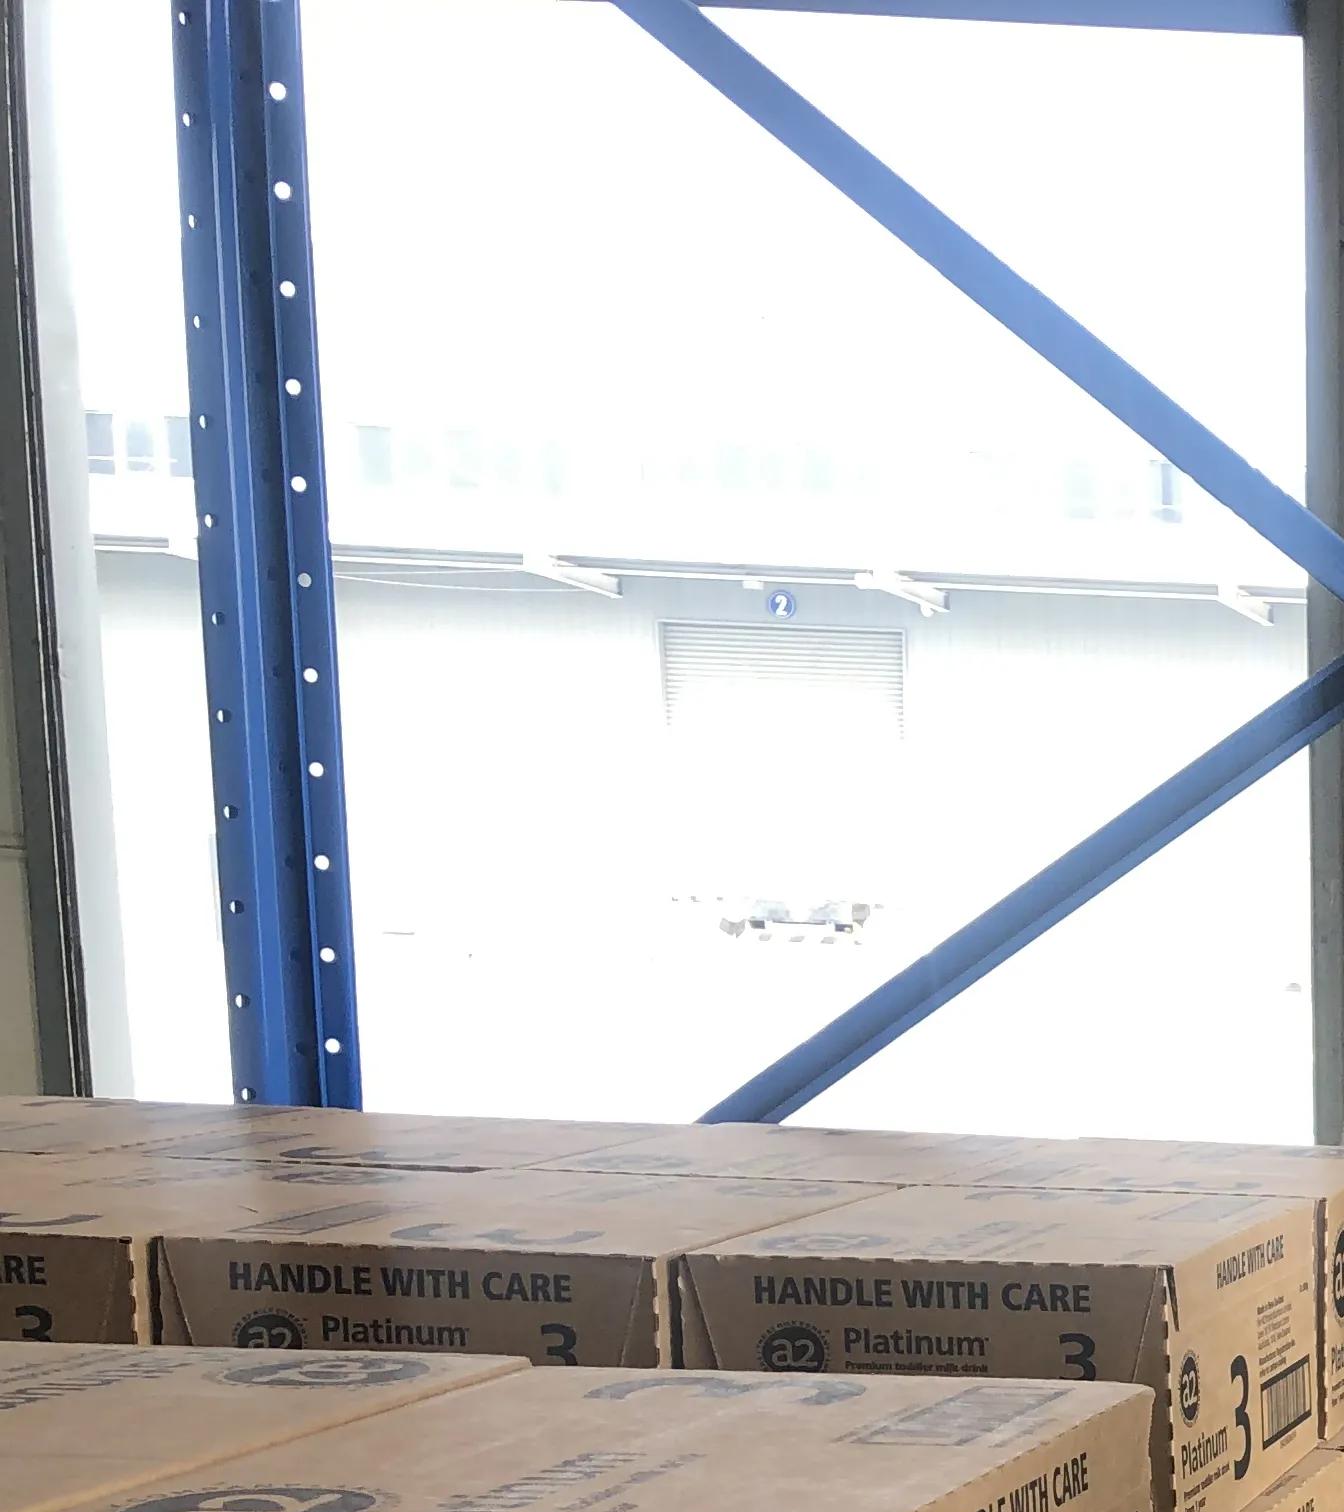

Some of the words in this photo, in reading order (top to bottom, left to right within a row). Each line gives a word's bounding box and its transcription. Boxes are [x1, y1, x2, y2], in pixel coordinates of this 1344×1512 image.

[775, 595, 788, 615] 2
[228, 1261, 372, 1296] HANDLE
[380, 1268, 470, 1299] WITH
[481, 1272, 573, 1303] CARE
[1216, 1244, 1246, 1289] HANDLE
[1245, 1243, 1267, 1274] WITH
[1266, 1234, 1284, 1265] CARE
[753, 1276, 892, 1307] HANDLE
[900, 1279, 988, 1311] WITH
[1002, 1283, 1091, 1312] CARE
[15, 1305, 52, 1342] 3
[321, 1315, 467, 1347] Platinum
[540, 1323, 578, 1366] 3
[843, 1327, 985, 1357] Platinum
[771, 1338, 819, 1368] a2
[1058, 1333, 1097, 1381] 3
[1180, 1370, 1199, 1414] a2
[1230, 1354, 1251, 1481] 3
[1181, 1425, 1228, 1480] Platinum
[1052, 1452, 1089, 1508] CARE
